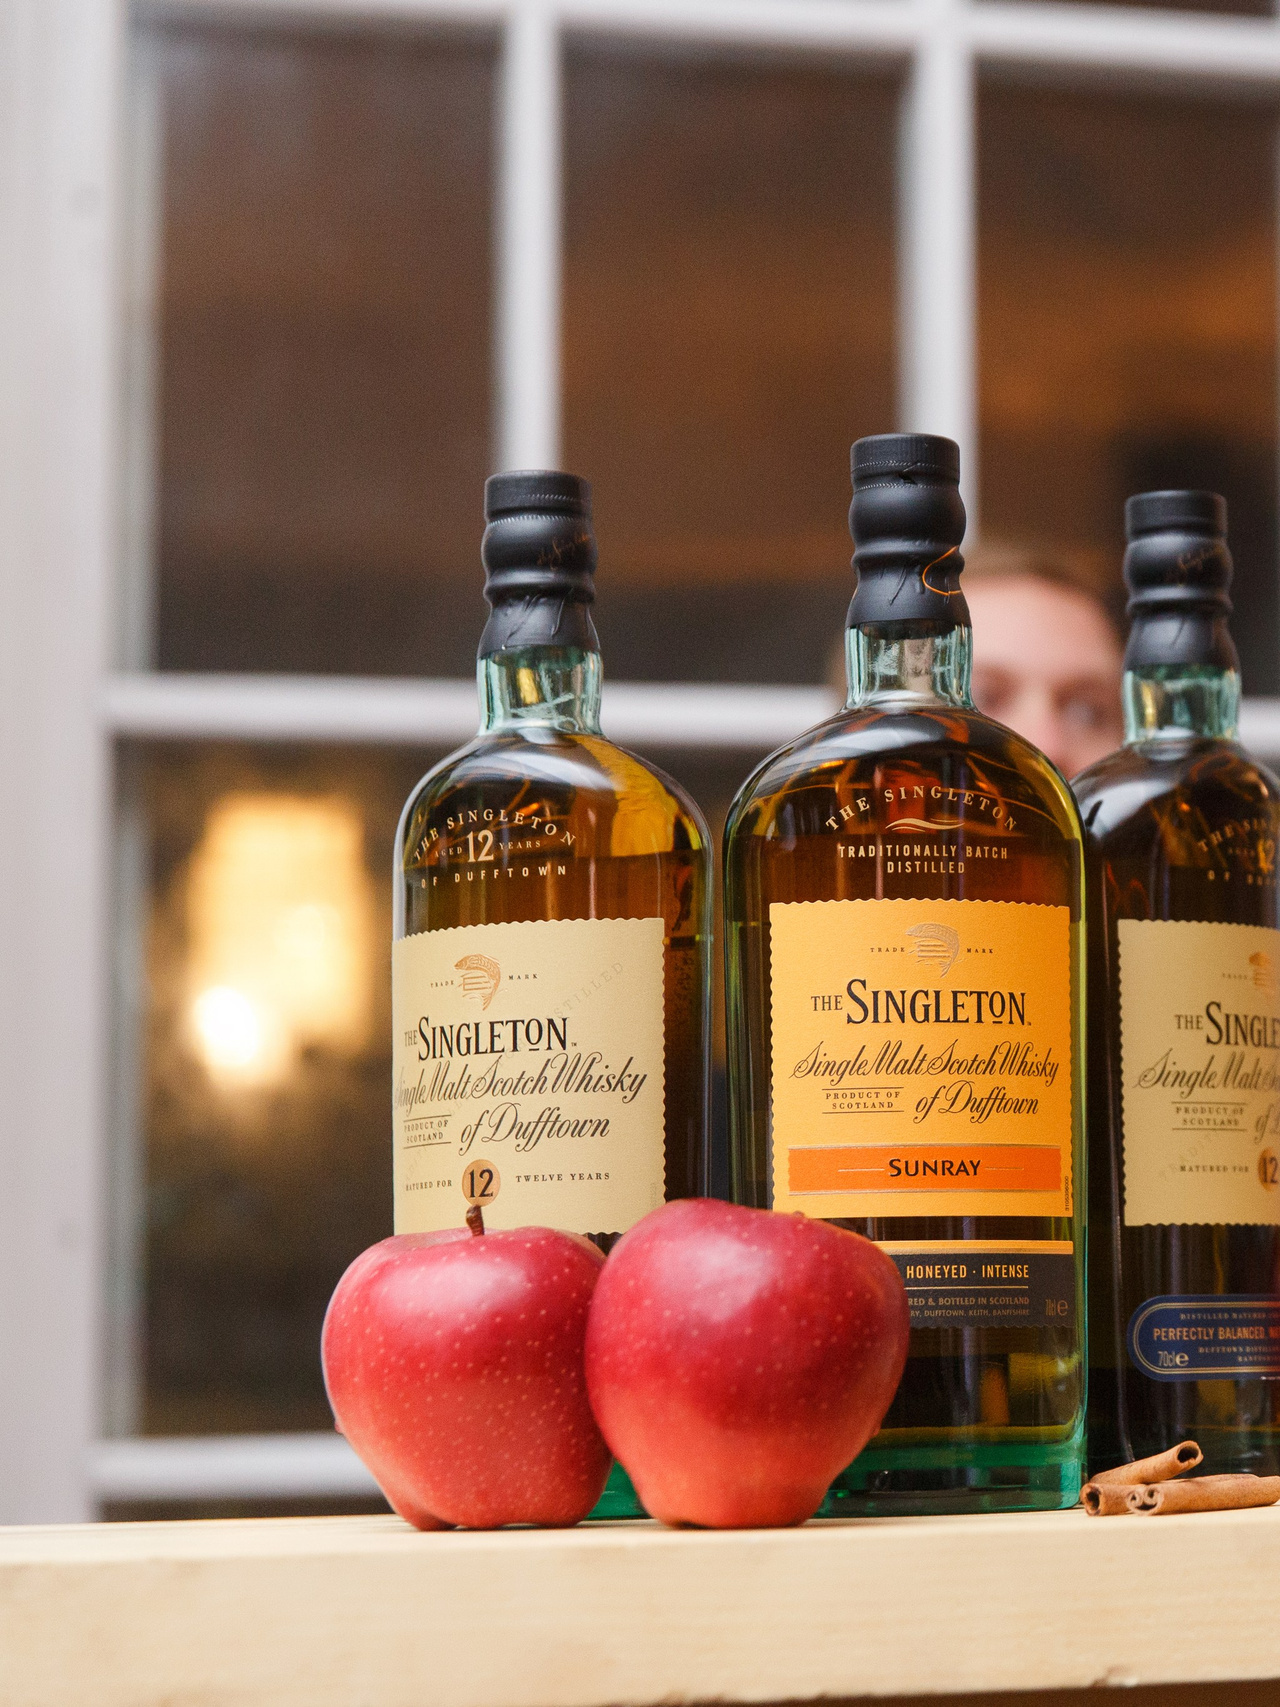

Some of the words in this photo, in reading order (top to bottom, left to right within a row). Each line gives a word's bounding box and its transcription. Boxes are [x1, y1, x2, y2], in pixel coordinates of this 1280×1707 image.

[825, 796, 870, 832] THE
[884, 784, 1018, 832] SINGLETON
[413, 827, 440, 862] THE
[446, 808, 576, 847] SINGLETON
[434, 846, 463, 858] AGED
[466, 829, 495, 863] 12
[499, 839, 541, 850] YEARS
[838, 844, 958, 859] TRADITIONALLY
[965, 845, 1008, 860] BATCH
[886, 861, 966, 875] DISTILLED
[421, 876, 438, 889] OF
[454, 865, 566, 883] DUFFTOWN
[508, 973, 538, 981] MARK
[810, 994, 843, 1012] THE
[845, 978, 1027, 1026] SINGLETON
[1174, 1014, 1204, 1030] THE
[404, 1029, 418, 1048] THE
[417, 1015, 570, 1062] SINGLETON
[789, 1040, 867, 1087] Single
[864, 1039, 928, 1078] Malt
[925, 1038, 999, 1078] Scotch
[998, 1040, 1060, 1088] Whisky
[424, 1059, 472, 1105] Malt
[469, 1054, 549, 1100] Scotch
[549, 1051, 648, 1104] Whisky
[1132, 1047, 1219, 1099] Single
[825, 1091, 881, 1100] PRODUCT
[886, 1091, 901, 1099] OF
[912, 1085, 943, 1124] of
[937, 1079, 1039, 1124] Dufftown
[831, 1101, 894, 1110] SCOTLAND
[1175, 1105, 1229, 1115] PRODUCT
[1233, 1106, 1244, 1115] OF
[403, 1121, 435, 1133] PRODUCT
[438, 1119, 449, 1129] OF
[458, 1109, 490, 1157] of
[481, 1101, 610, 1153] Dufftown
[1182, 1118, 1240, 1127] SCOTLAND
[406, 1131, 444, 1144] SCOTLAND
[888, 1157, 982, 1177] SUNRAY
[1180, 1165, 1229, 1173] MATURED
[1262, 1155, 1280, 1184] 12
[436, 1179, 453, 1188] FOR
[468, 1167, 495, 1199] 12
[515, 1172, 564, 1183] TWELVE
[570, 1171, 611, 1181] YEARS
[906, 1264, 968, 1279] HONEYED
[981, 1264, 1029, 1279] INTENSE
[927, 1298, 936, 1306] &
[938, 1297, 976, 1306] BOTTLED
[978, 1297, 988, 1305] IN
[989, 1296, 1030, 1305] SCOTLAND
[1153, 1326, 1215, 1341] PERFECTLY
[1218, 1325, 1266, 1340] BALANCED
